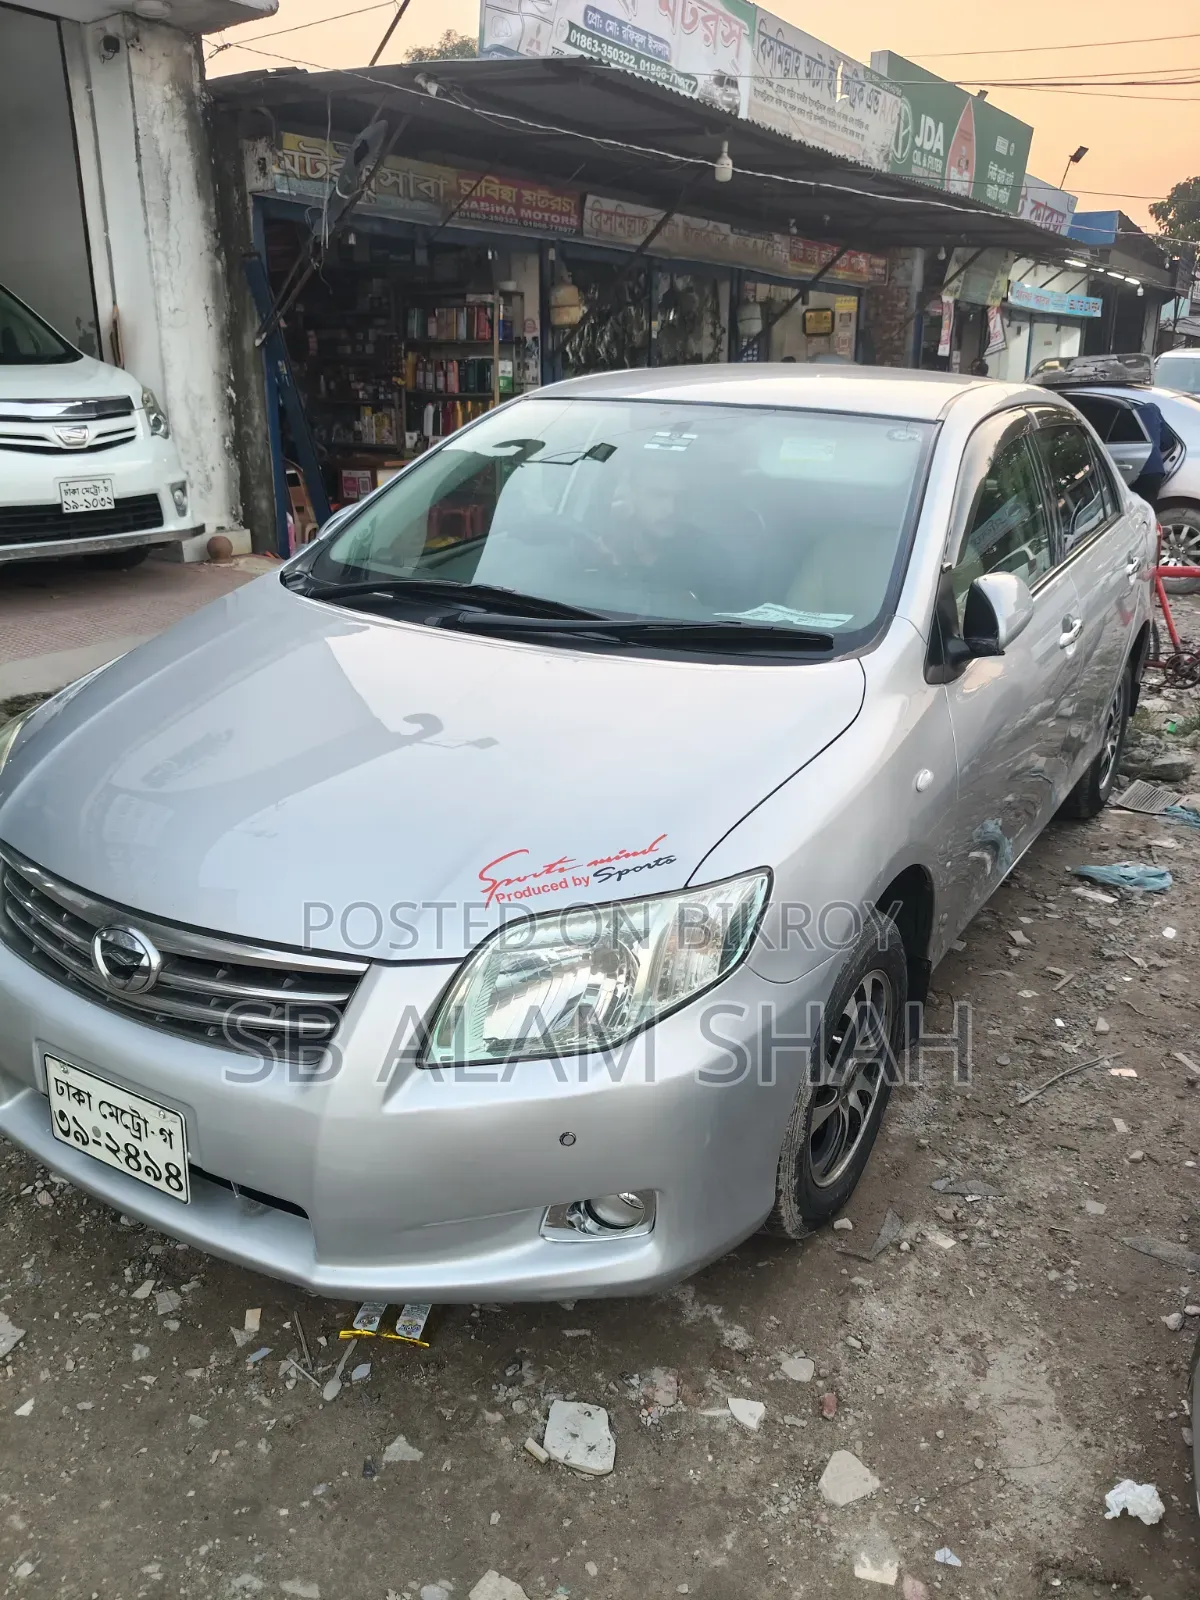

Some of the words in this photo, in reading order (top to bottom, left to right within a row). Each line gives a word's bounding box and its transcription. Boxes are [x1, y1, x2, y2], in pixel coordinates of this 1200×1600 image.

[570, 28, 638, 71] 01863-350322,
[915, 113, 944, 157] JDA
[520, 207, 579, 227] MOTORS
[64, 487, 80, 496] ঢাকা
[479, 849, 583, 911] Sports
[586, 834, 668, 867] mind
[494, 879, 570, 905] Produced
[571, 875, 591, 888] by
[592, 854, 677, 884] Sports
[54, 1077, 92, 1112] ঢাকা
[53, 1109, 184, 1192] ৩৯-২৪৯৪
